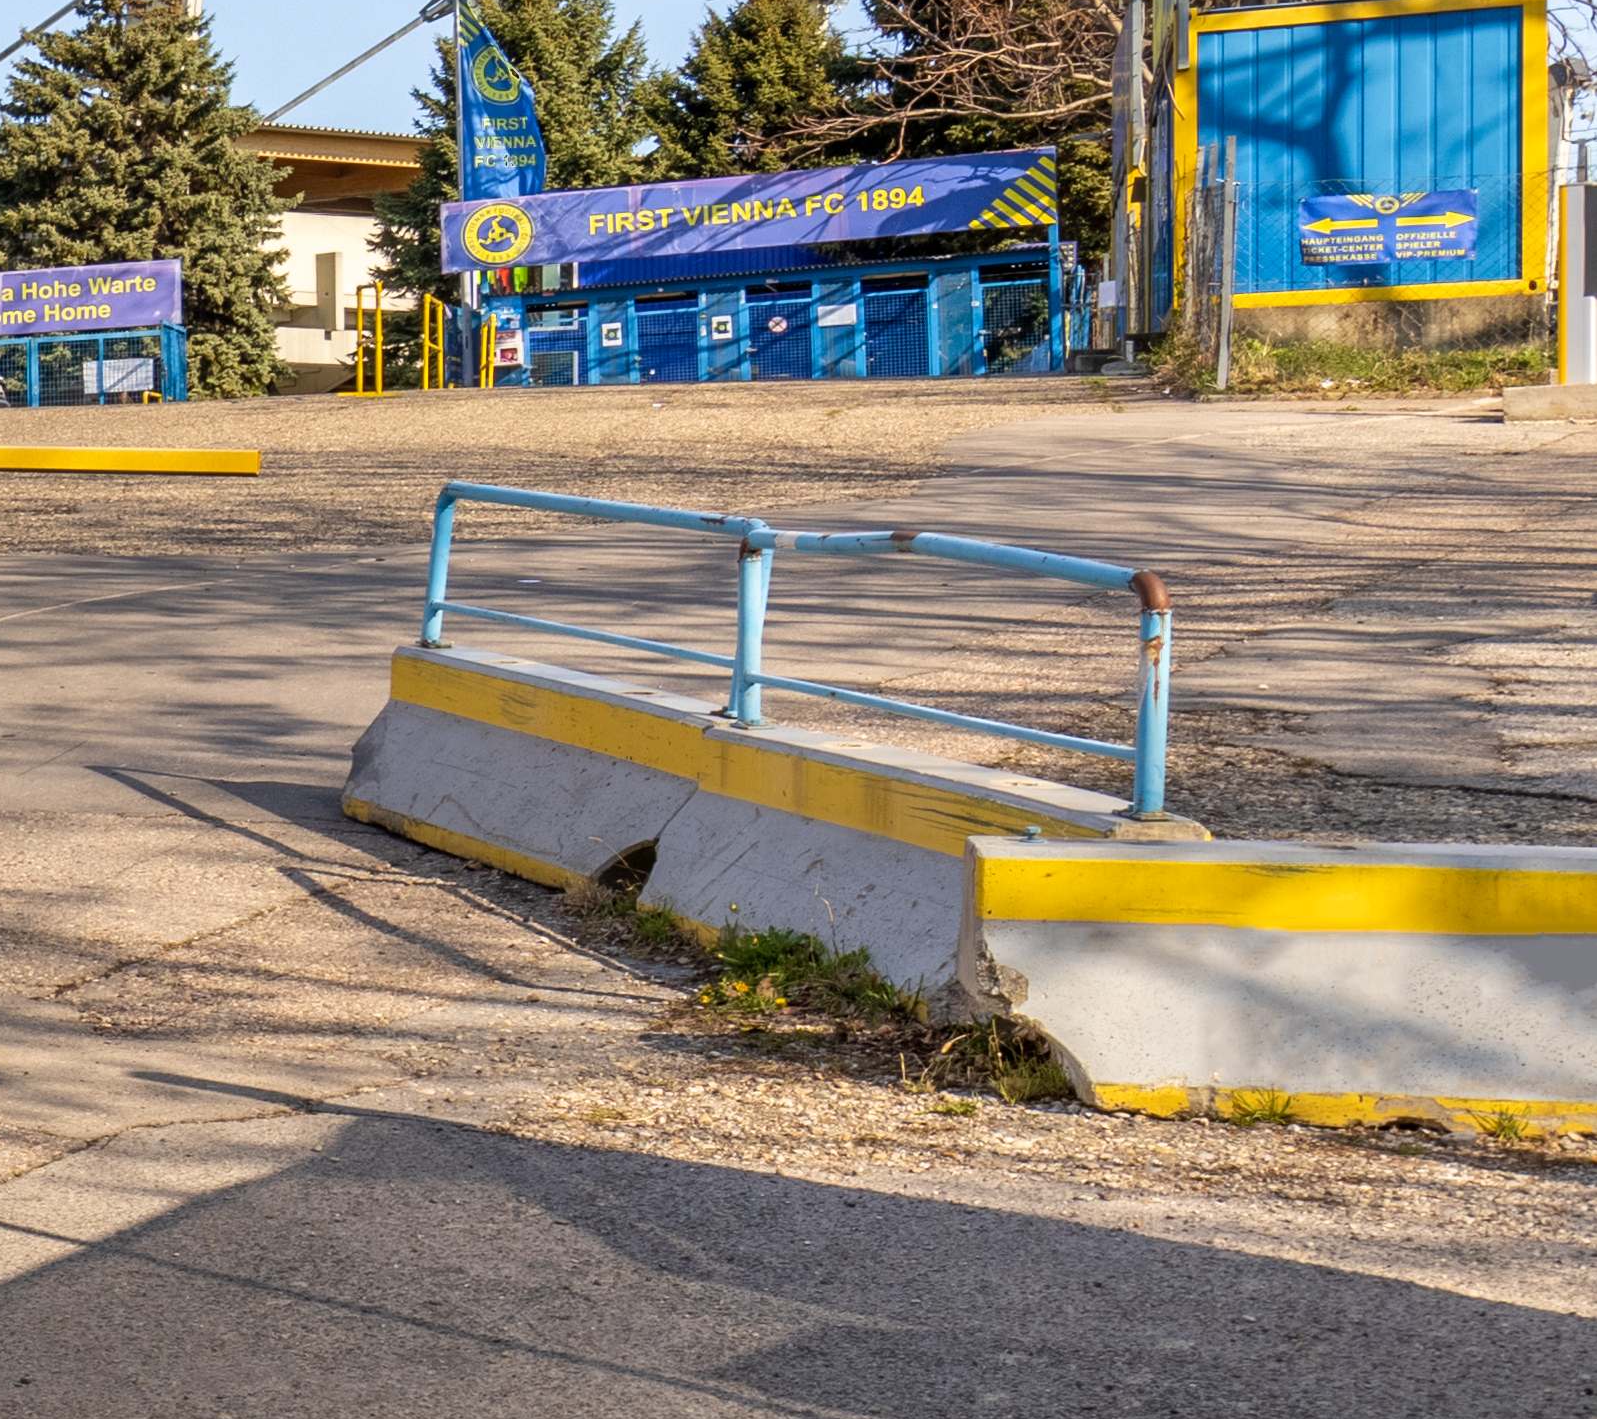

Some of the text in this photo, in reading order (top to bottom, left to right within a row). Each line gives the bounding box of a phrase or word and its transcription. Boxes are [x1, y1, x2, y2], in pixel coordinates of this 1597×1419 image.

[482, 116, 528, 130] FIRST
[474, 135, 536, 149] VIENNA
[474, 153, 536, 169] FC 1894
[588, 185, 925, 235] FIRST VIENNA FC 1894
[1301, 235, 1384, 245] HAUPTEINGANG
[1396, 231, 1457, 241] OFFIZIELLE
[1303, 244, 1384, 254] TICKET-CENTER
[1396, 241, 1441, 249] SPIELER
[1396, 249, 1465, 259] VIP-PREMIUM
[21, 280, 82, 301] Hohe
[88, 275, 157, 296] Warte
[44, 302, 112, 323] Home
